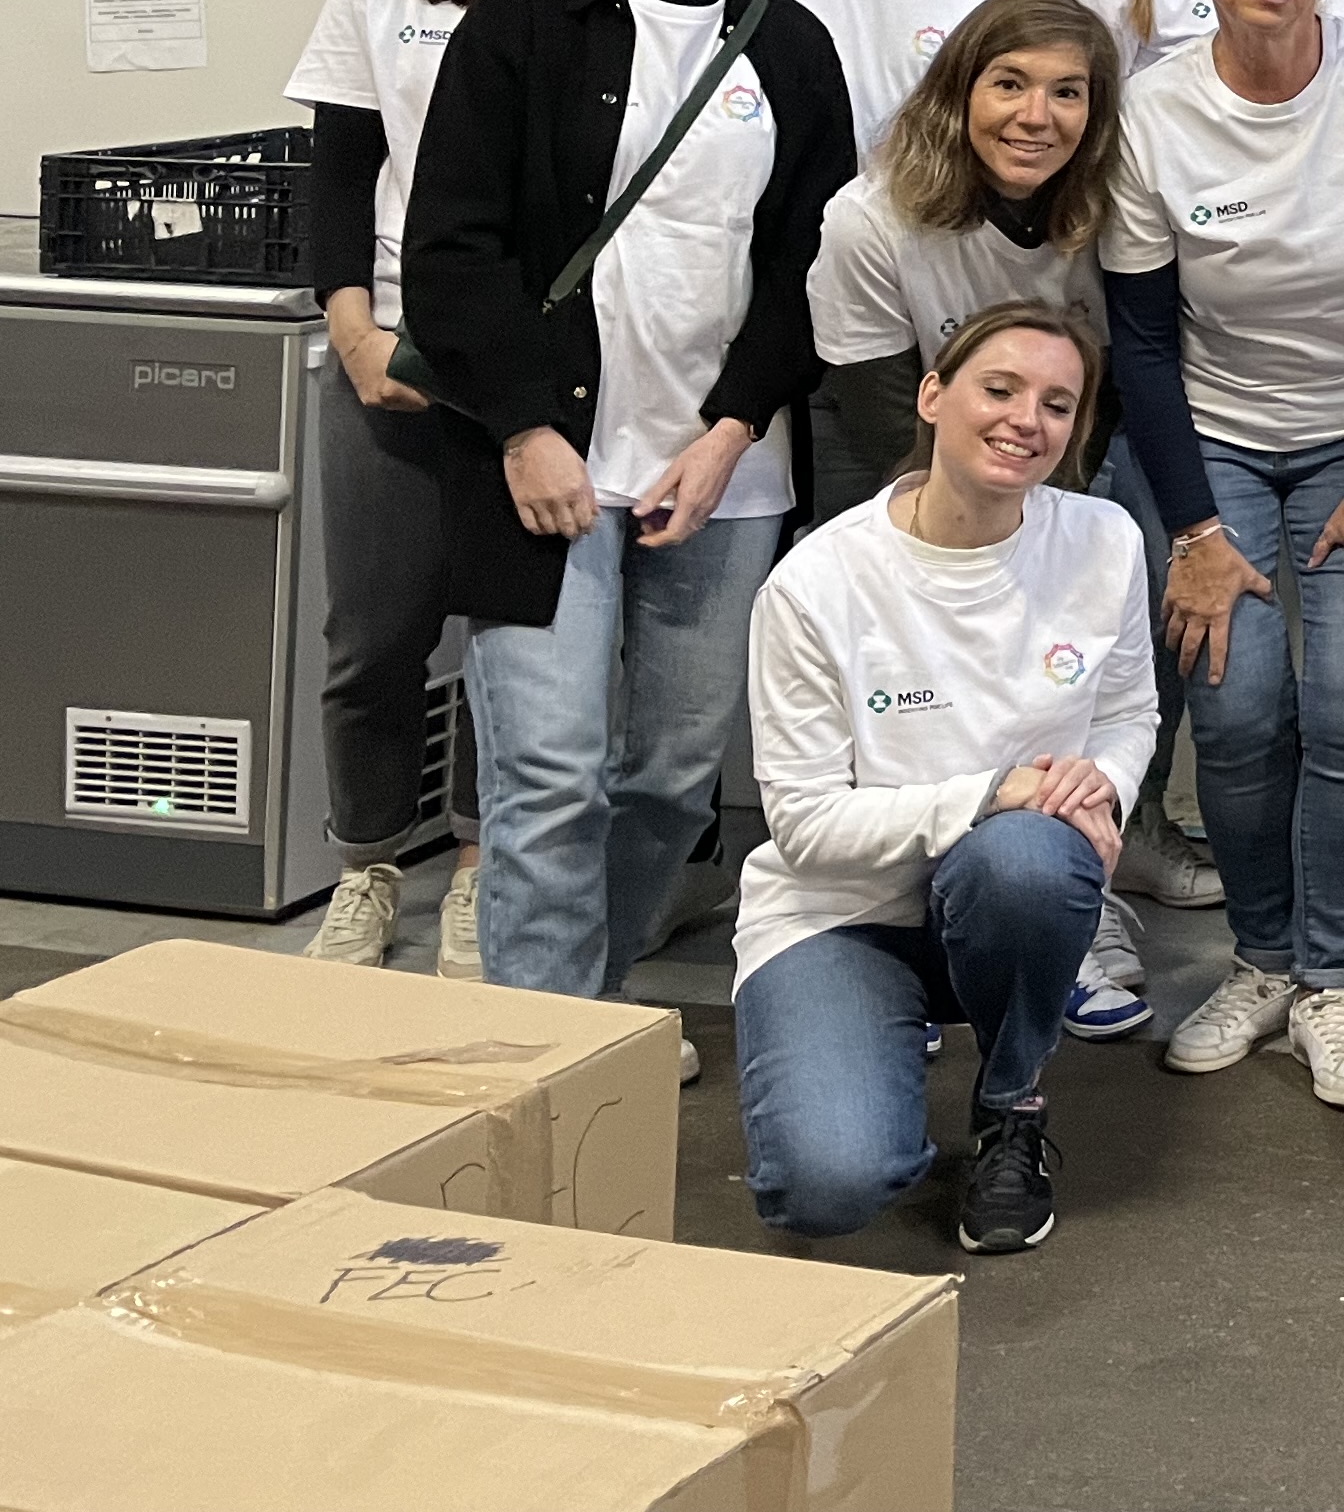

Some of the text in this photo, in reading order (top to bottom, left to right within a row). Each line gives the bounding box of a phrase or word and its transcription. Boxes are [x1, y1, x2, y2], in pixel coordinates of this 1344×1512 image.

[420, 29, 452, 41] MSD
[1216, 201, 1248, 218] MSD
[134, 362, 236, 390] picard
[898, 689, 935, 707] MSD
